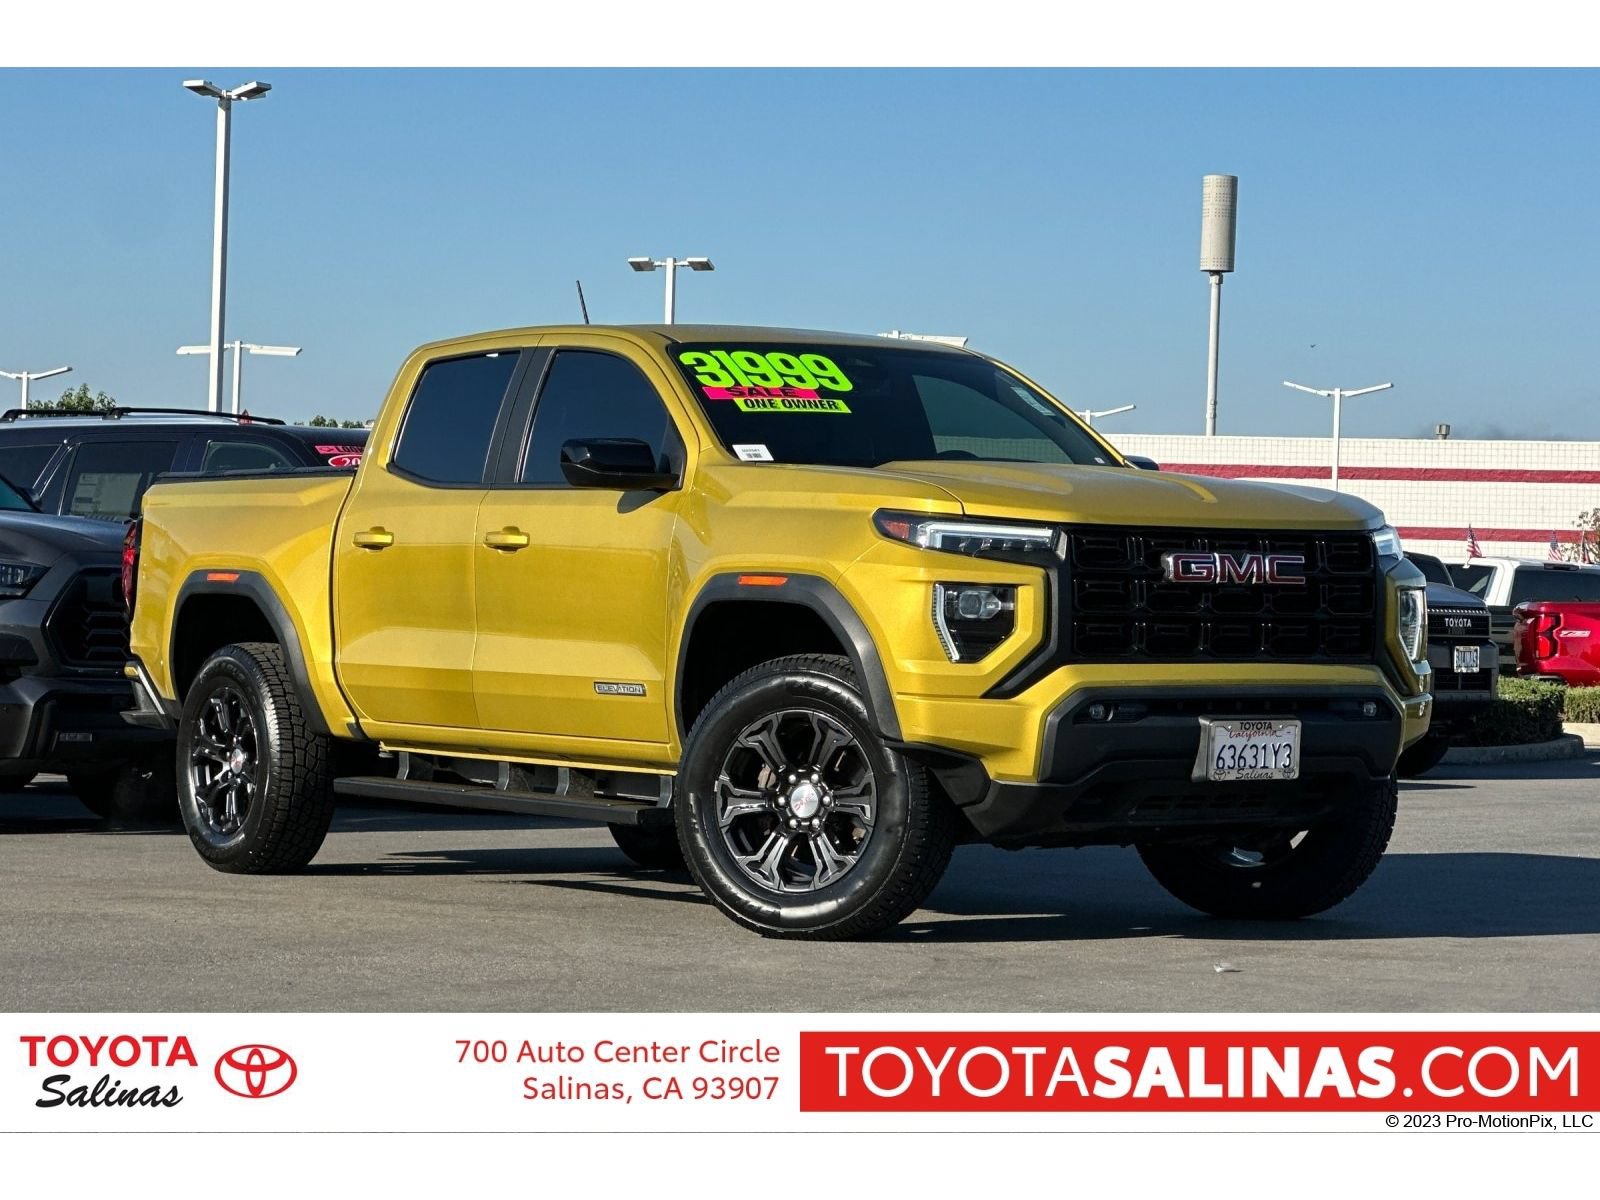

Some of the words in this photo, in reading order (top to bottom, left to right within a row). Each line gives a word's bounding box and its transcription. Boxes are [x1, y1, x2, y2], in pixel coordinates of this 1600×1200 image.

[679, 350, 853, 392] 31999
[724, 387, 797, 398] SALE
[744, 398, 778, 409] ONE
[782, 399, 840, 410] OWNER
[1167, 553, 1306, 584] GMC
[1445, 618, 1472, 627] TOYOTA
[597, 684, 641, 693] ELEVATION
[1240, 721, 1273, 731] TOYOTA
[1229, 730, 1277, 742] California
[1216, 743, 1293, 769] 63631Y3
[1235, 768, 1274, 780] Salinas
